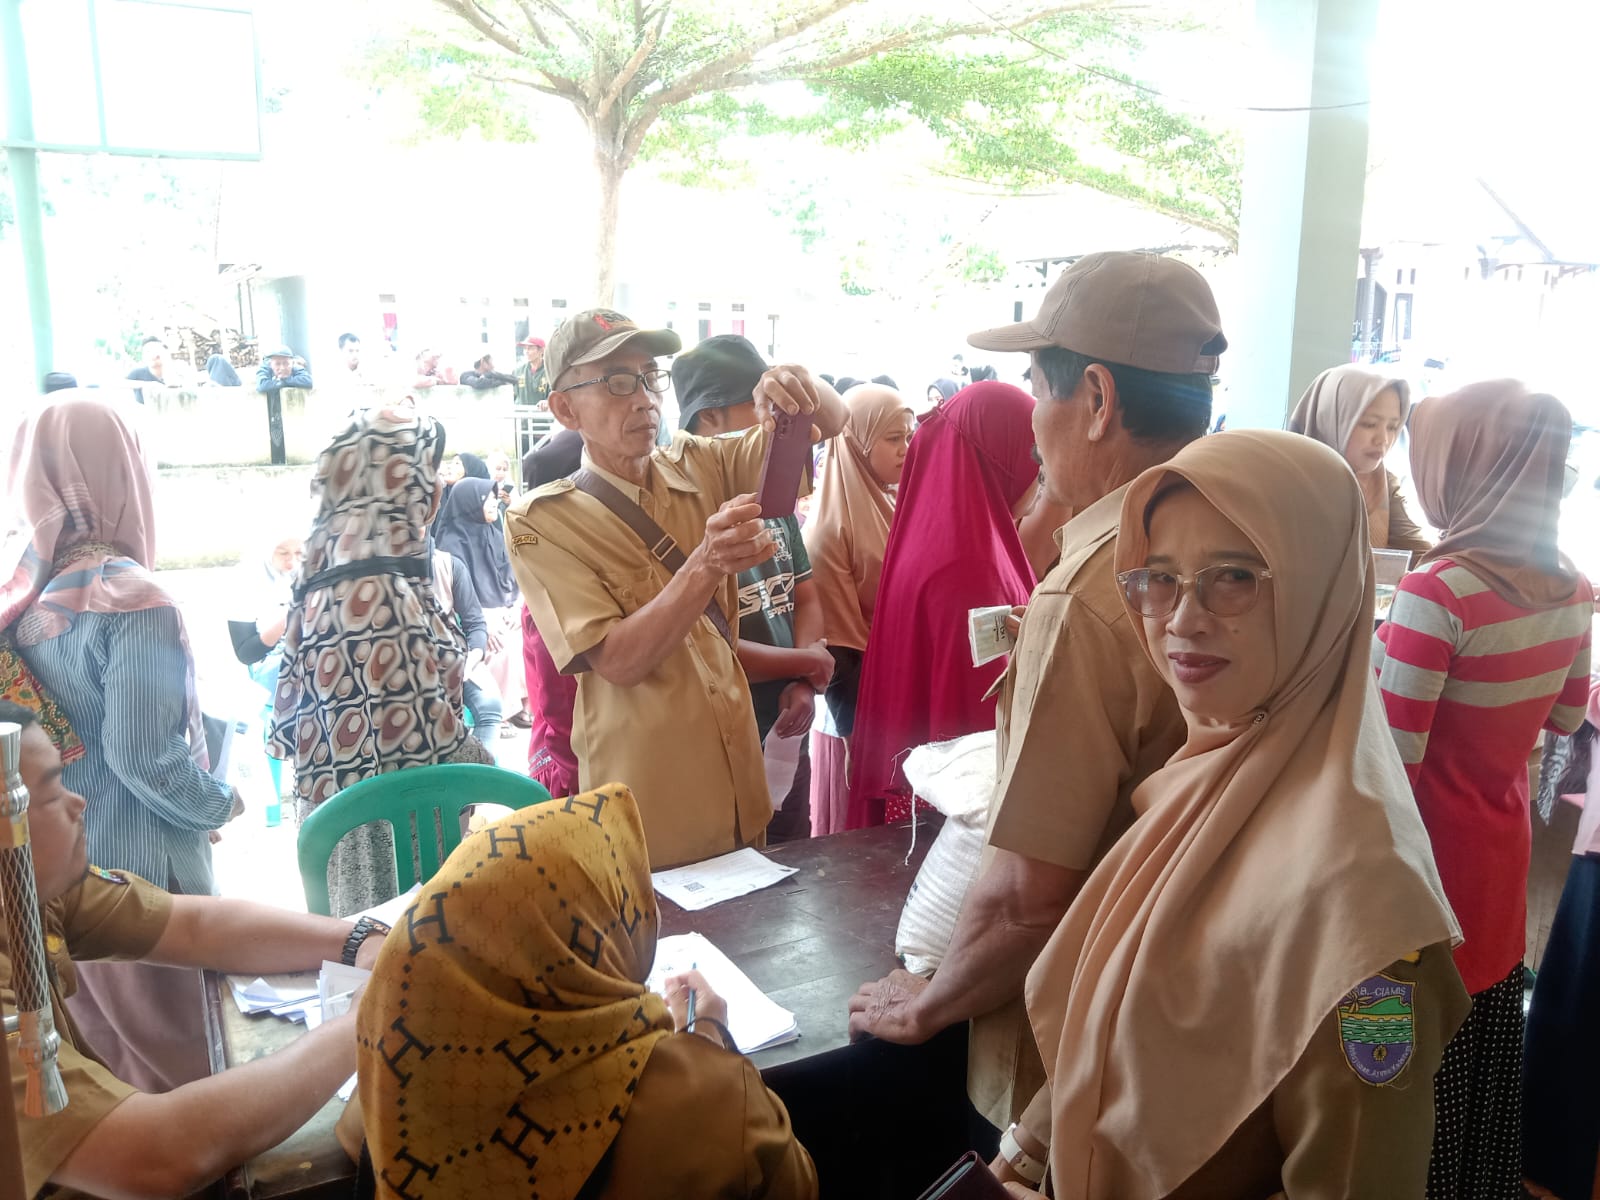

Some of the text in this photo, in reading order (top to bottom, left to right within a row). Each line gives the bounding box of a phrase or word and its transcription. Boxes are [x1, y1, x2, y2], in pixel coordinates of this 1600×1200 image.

[485, 825, 533, 861] H
[405, 892, 455, 956] H
[1375, 986, 1406, 996] CIAMIS
[377, 1016, 435, 1089] H
[493, 1028, 564, 1085] H
[490, 1102, 557, 1170] H
